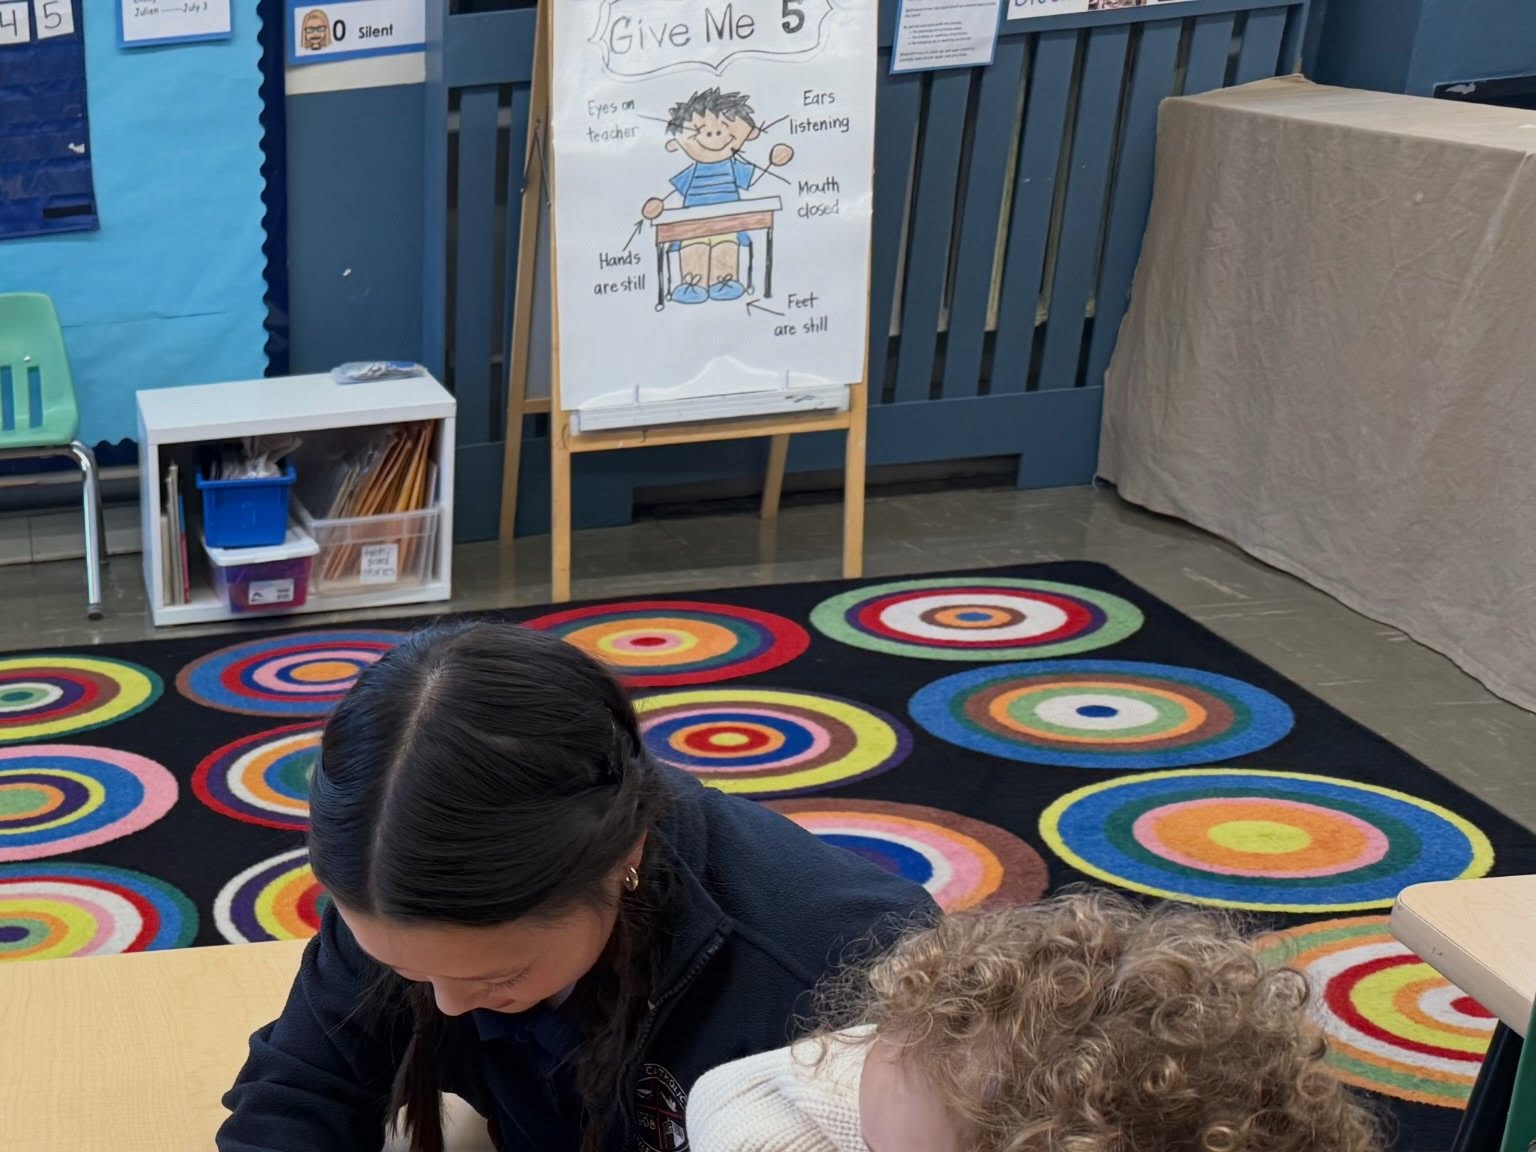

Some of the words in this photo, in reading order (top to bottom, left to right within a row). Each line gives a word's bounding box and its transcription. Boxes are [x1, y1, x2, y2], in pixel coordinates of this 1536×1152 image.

[0, 9, 17, 37] 4
[43, 1, 62, 30] 5
[609, 16, 691, 54] Give
[705, 2, 755, 43] Me
[781, 0, 805, 34] 5
[332, 19, 346, 41] 0
[358, 24, 393, 39] Silent
[804, 89, 835, 106] Ears
[588, 99, 617, 117] Eyes
[621, 99, 635, 111] on
[587, 125, 639, 142] teacher
[790, 116, 850, 134] listening
[798, 176, 839, 195] Mouth
[798, 199, 839, 219] closed
[599, 251, 641, 269] Hands
[594, 282, 621, 296] are
[620, 274, 646, 292] still
[787, 293, 818, 309] Feet
[774, 324, 797, 337] are
[802, 316, 828, 334] still
